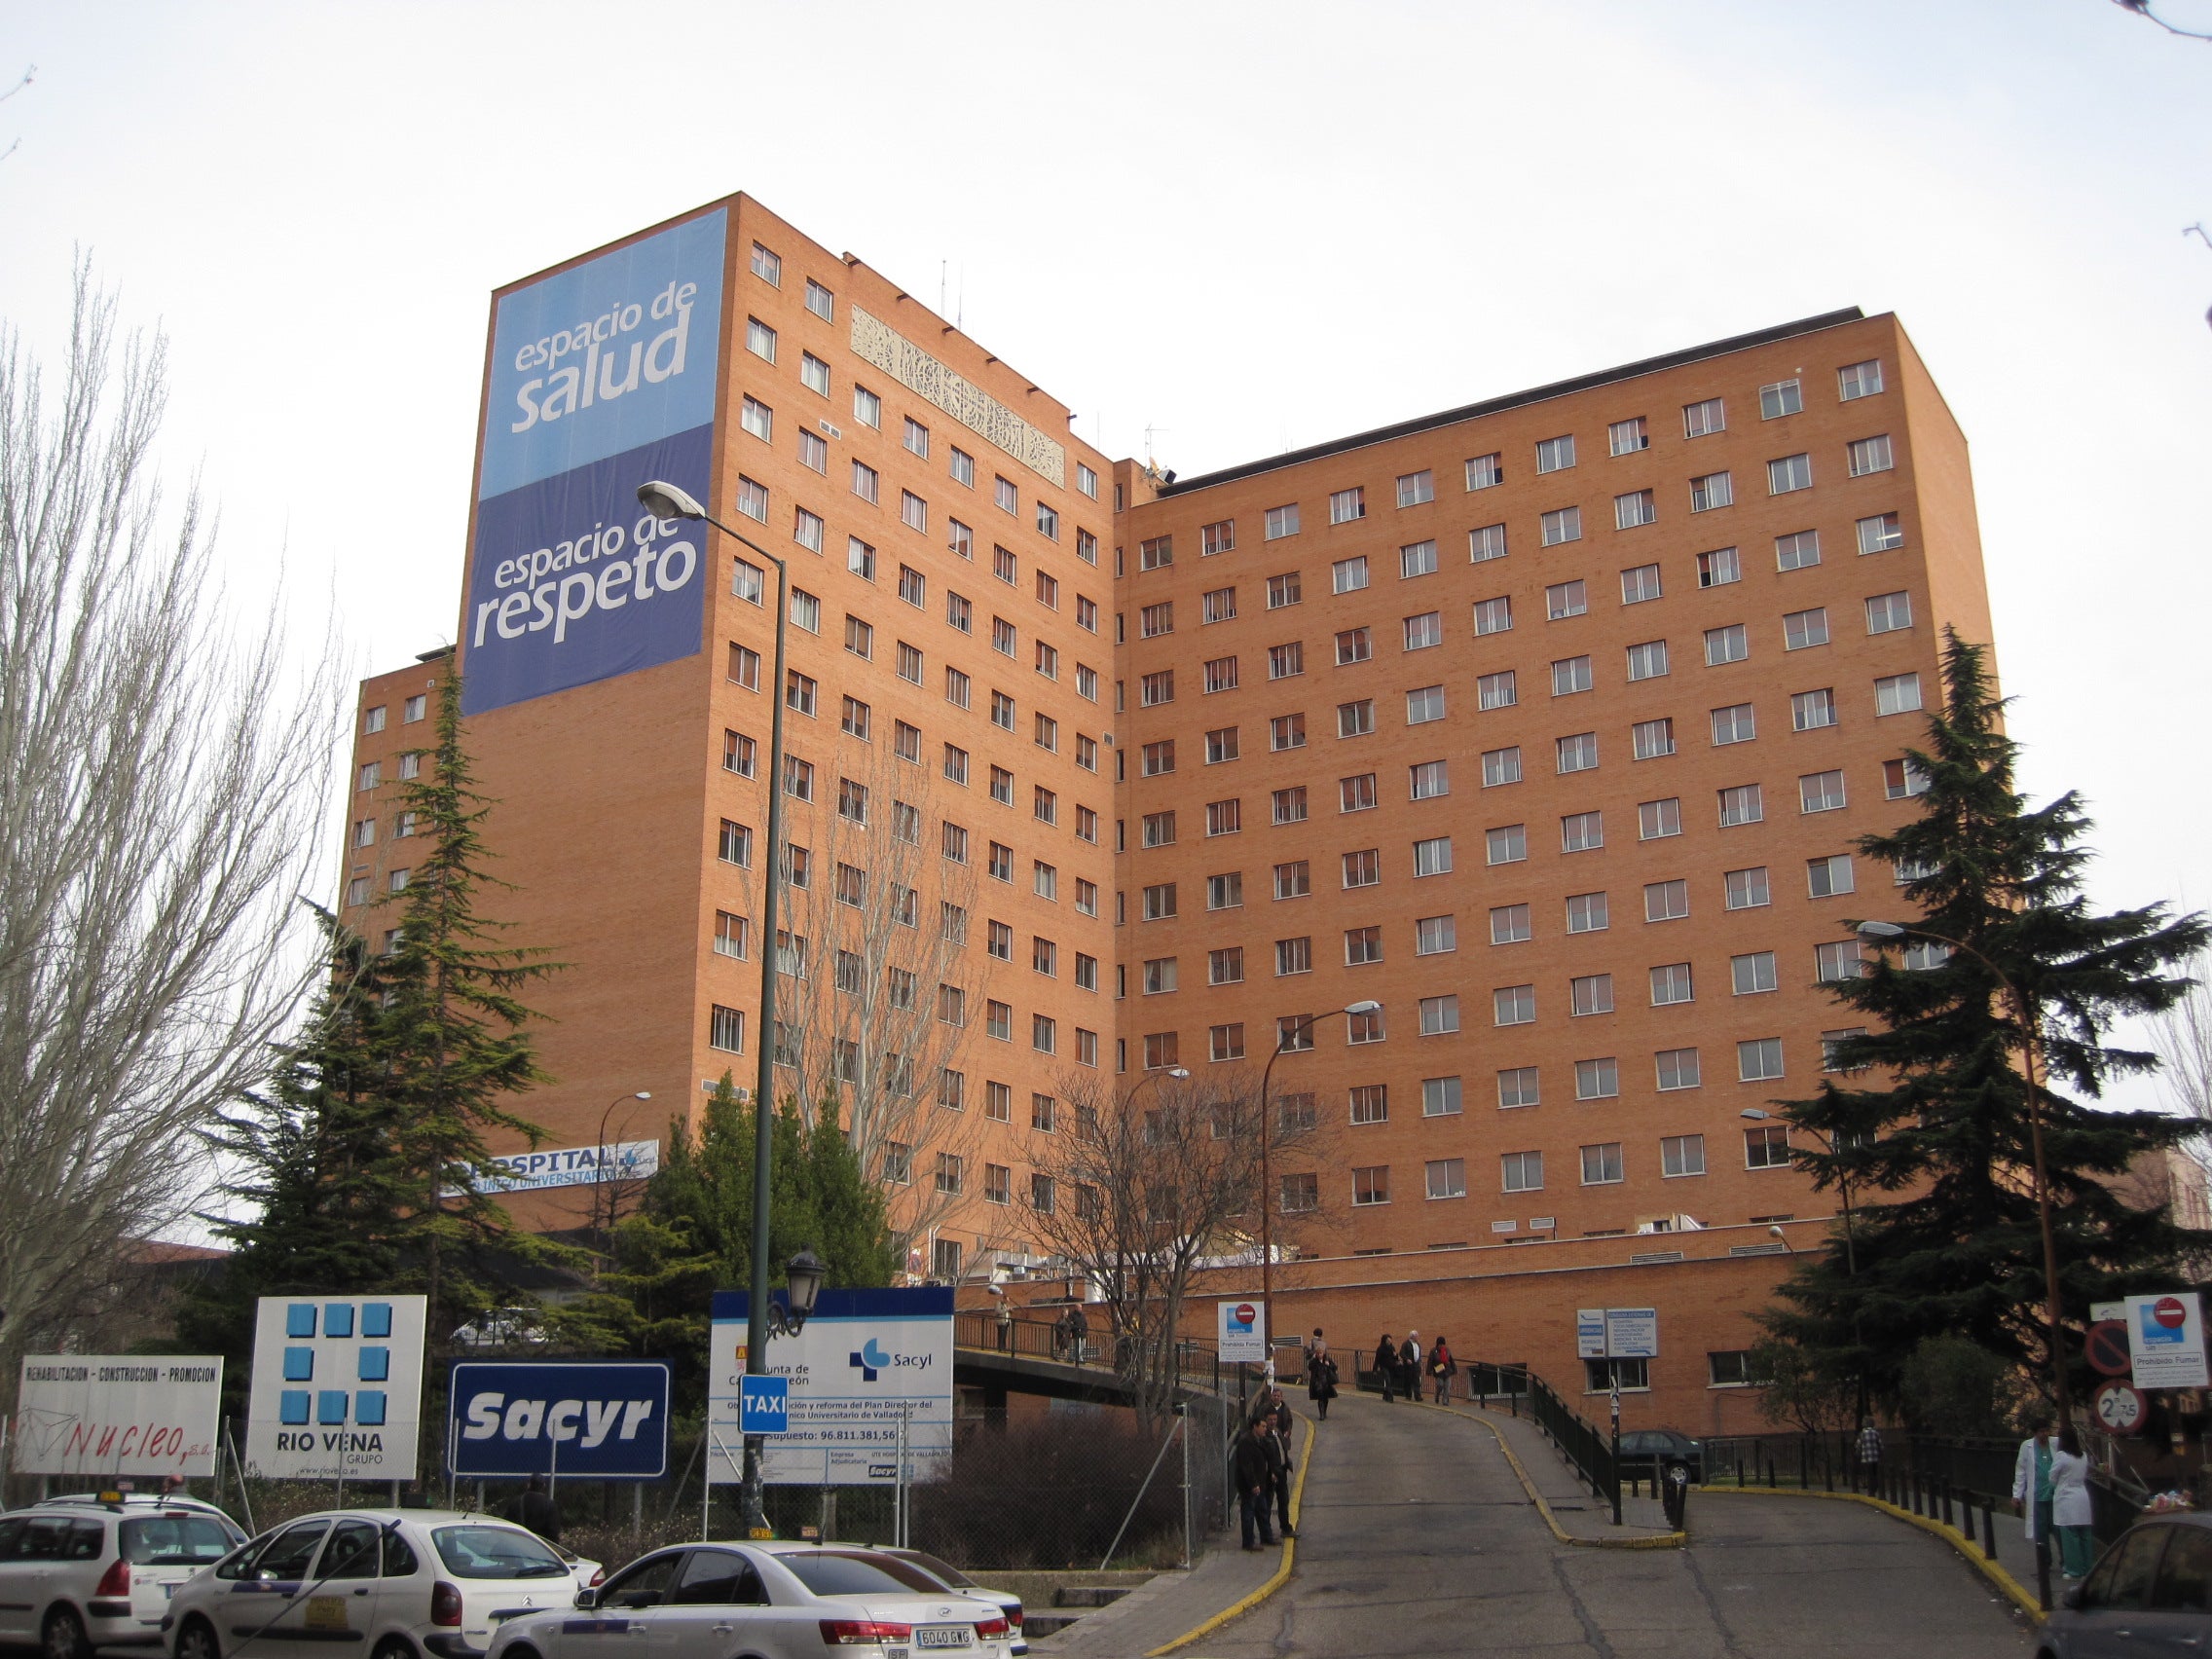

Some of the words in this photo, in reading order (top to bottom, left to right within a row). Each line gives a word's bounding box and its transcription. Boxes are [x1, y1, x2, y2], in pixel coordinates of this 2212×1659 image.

[515, 301, 643, 371] espacio
[650, 279, 697, 320] de
[511, 306, 691, 434] salud
[495, 521, 626, 591] espacio
[473, 540, 697, 648] respeto
[765, 1365, 792, 1374] unta
[795, 1364, 809, 1374] de
[894, 1353, 933, 1369] Sacyl
[98, 1366, 159, 1382] CONSTRUCCION
[168, 1367, 216, 1382] PROMOCION
[789, 1375, 810, 1384] eón
[743, 1395, 787, 1414] TAXI
[816, 1401, 848, 1410] reforma
[851, 1400, 863, 1409] del
[919, 1400, 933, 1409] del
[462, 1391, 653, 1449] Sacyr
[807, 1411, 859, 1419] Universitario
[277, 1432, 315, 1452] RIO
[322, 1432, 383, 1452] VENA
[763, 1431, 819, 1442] esupuesto:
[820, 1430, 896, 1441] 96.811.381,56
[347, 1455, 384, 1464] GRUPO
[922, 1630, 948, 1645] 6040
